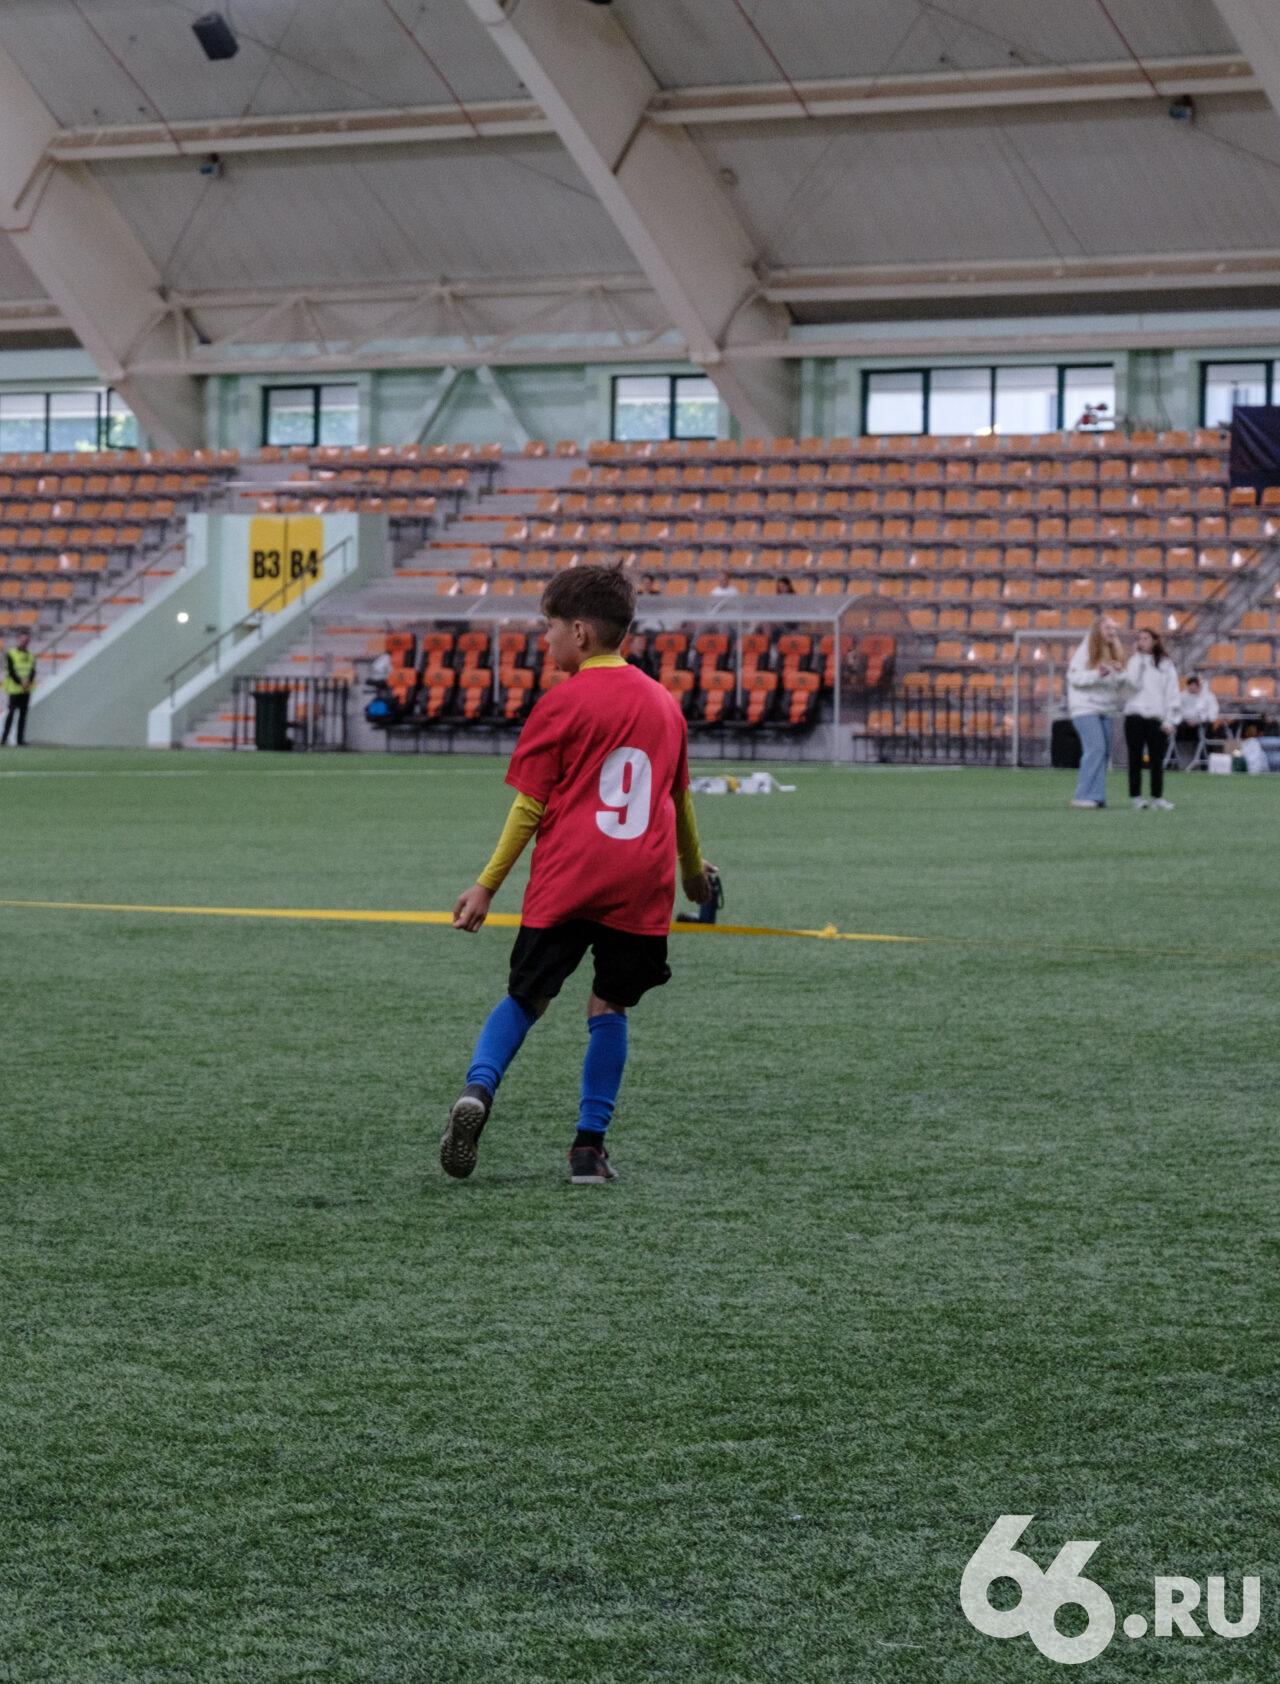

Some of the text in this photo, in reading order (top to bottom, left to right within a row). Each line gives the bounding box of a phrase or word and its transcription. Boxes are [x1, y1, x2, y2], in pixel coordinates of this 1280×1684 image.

[253, 549, 318, 579] B3 B4
[595, 746, 652, 840] 9
